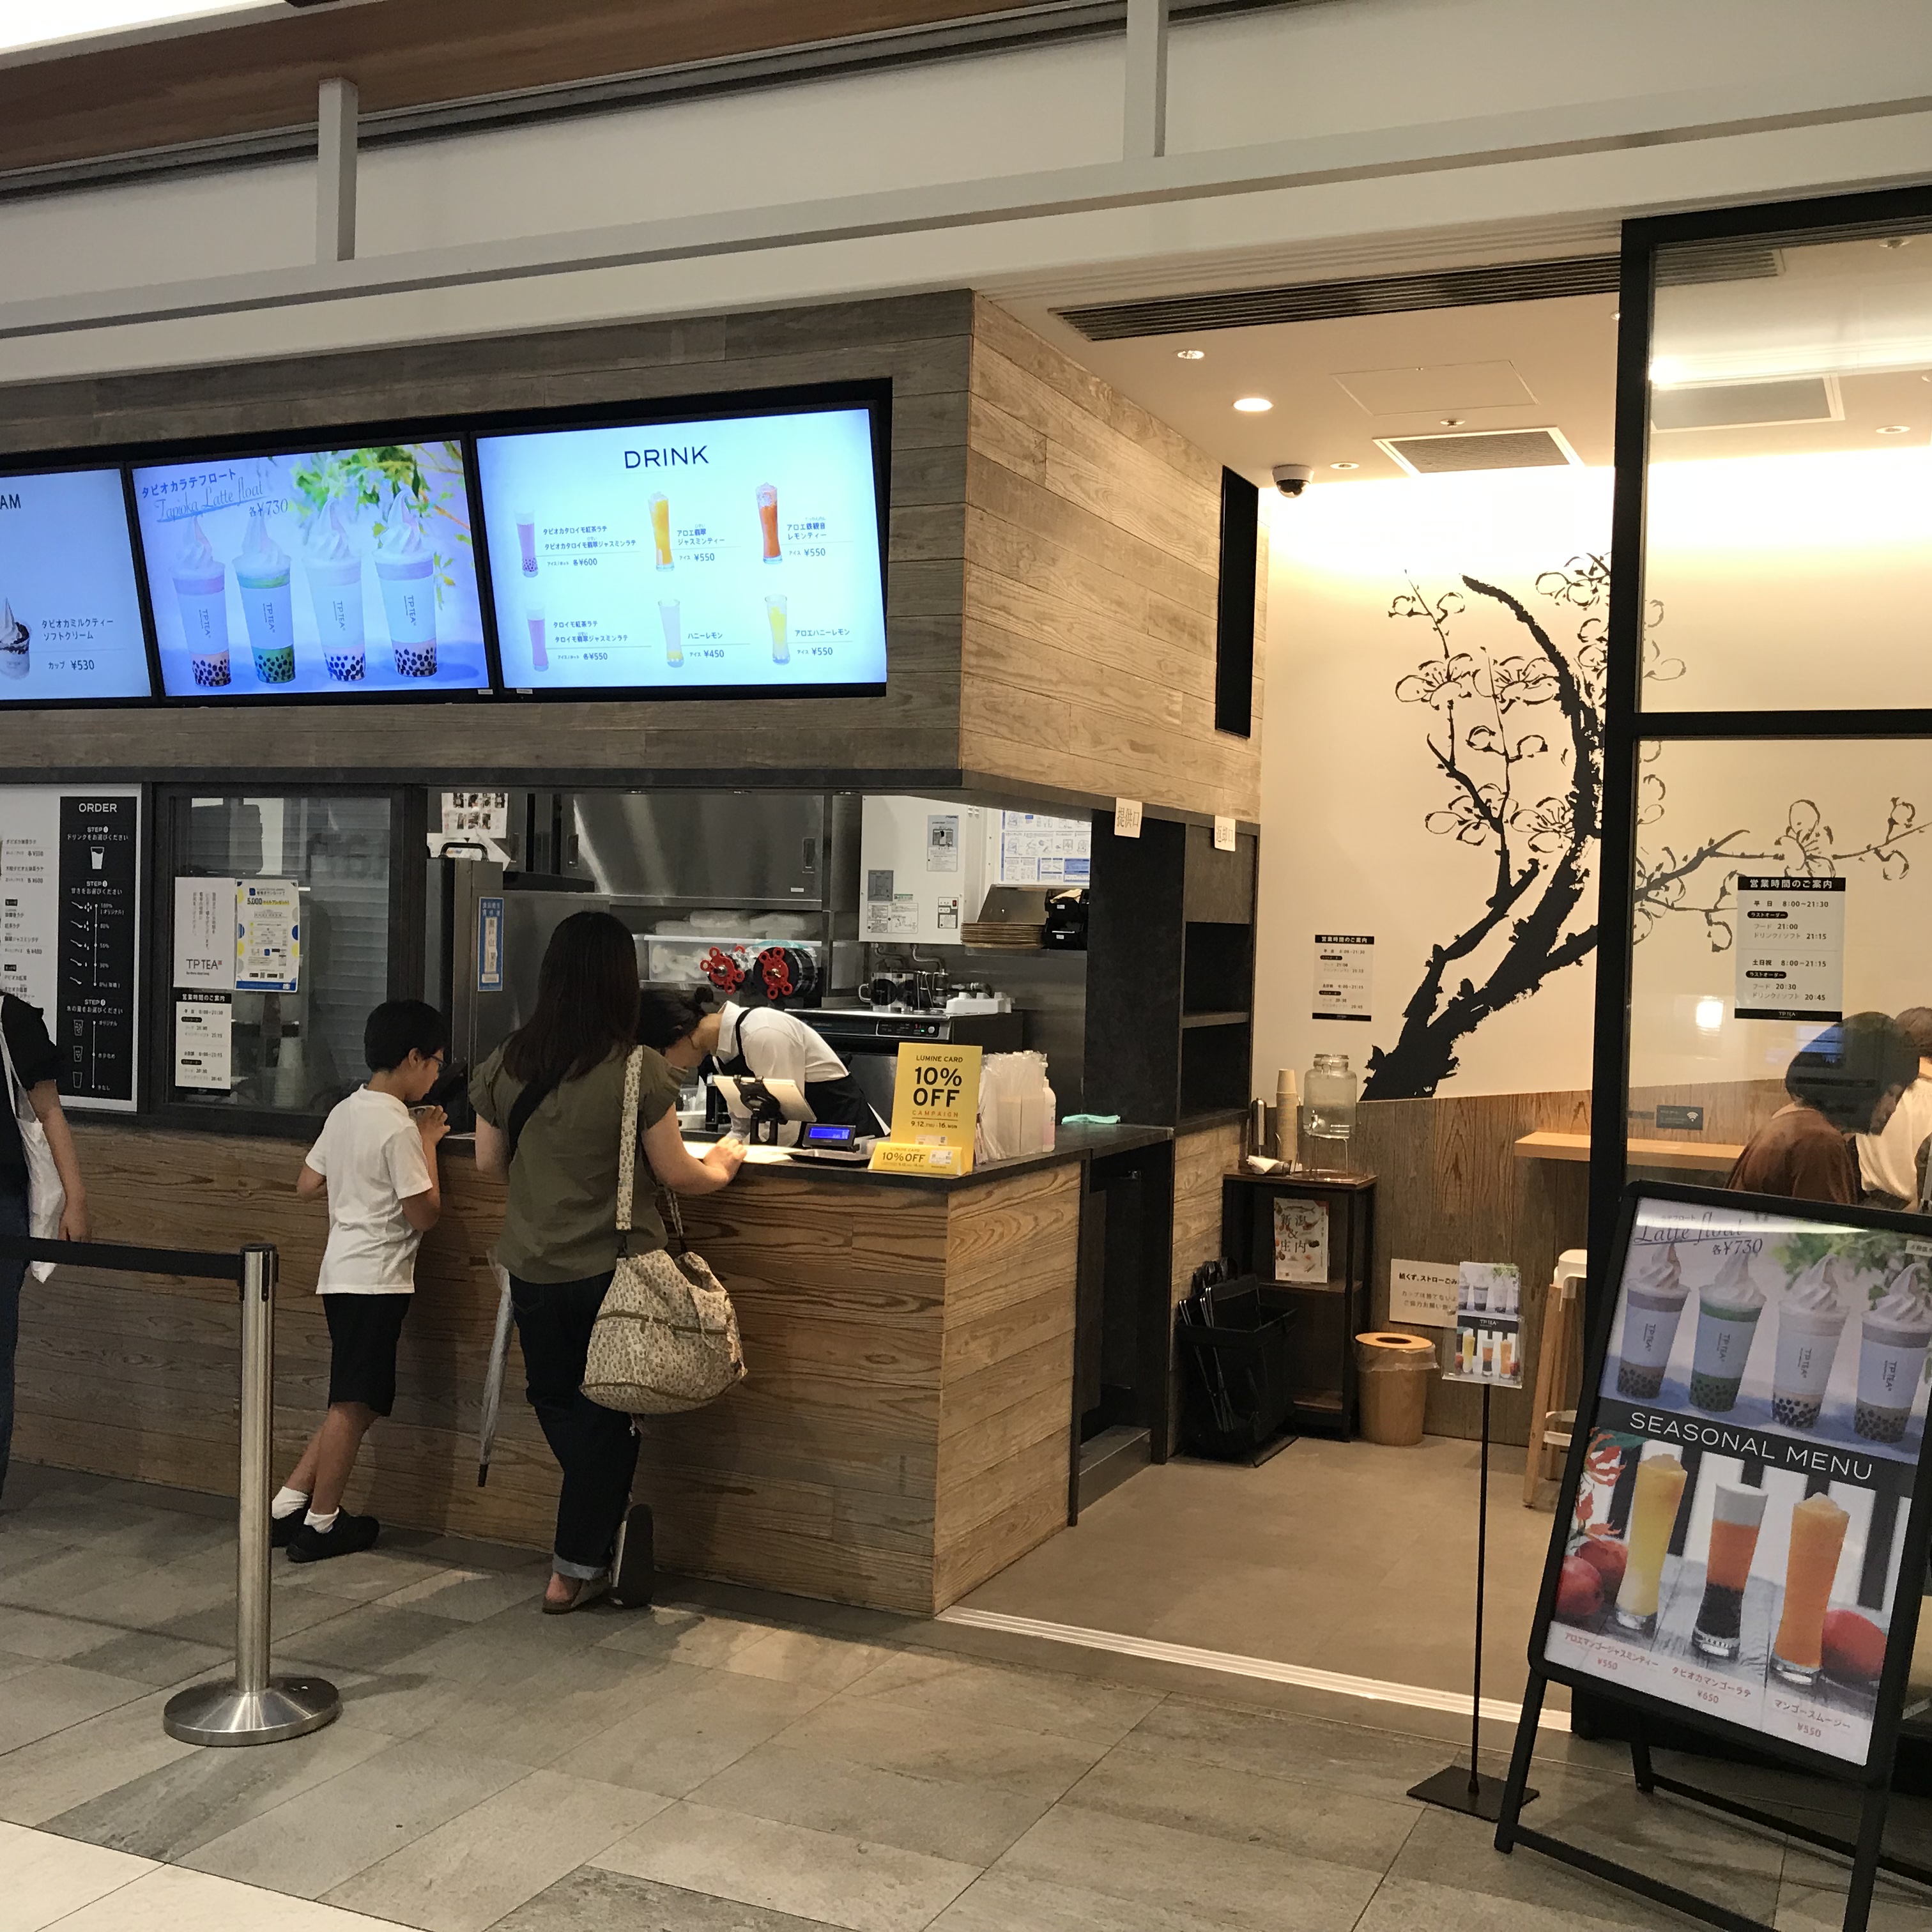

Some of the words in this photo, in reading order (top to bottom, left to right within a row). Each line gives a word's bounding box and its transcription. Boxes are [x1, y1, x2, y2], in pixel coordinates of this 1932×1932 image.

[624, 445, 710, 469] DRINK
[142, 468, 236, 498] タピオカラテフロート
[155, 492, 198, 521] Tapioka
[201, 486, 234, 509] Latte
[237, 476, 264, 506] float
[542, 526, 608, 535] タピオカタロイモ紅茶ラテ
[786, 522, 825, 531] アロエ鉄観音
[678, 537, 724, 546] ジャスミンティー
[788, 532, 827, 540] レモンティー
[694, 553, 715, 562] ¥550
[804, 548, 825, 557] ¥550
[42, 618, 113, 629] タピオカミルクティー
[553, 620, 598, 629] タロイモ紅茶ラテ
[43, 631, 94, 641] ソフトクリーム
[583, 652, 608, 661] 各¥550
[703, 649, 724, 658] ¥450
[811, 647, 833, 656] ¥550
[48, 661, 65, 670] カップ
[70, 659, 95, 670] ¥530
[79, 802, 118, 813] ORDER
[67, 833, 128, 841] ドリンクをお選びください
[1749, 879, 1832, 889] 営業時間のご案内
[915, 1066, 962, 1087] 10%
[913, 1087, 960, 1107] OFF
[912, 1110, 958, 1118] CAMPAIGN
[1633, 1217, 1689, 1243] Latte
[1694, 1211, 1742, 1245] float
[1287, 1229, 1298, 1239] &
[1280, 1239, 1306, 1253] 庄内
[1630, 1412, 1775, 1459] SEASONAL
[1786, 1445, 1873, 1480] MENU
[1565, 1632, 1659, 1666] アロエマンゴージャスミンティー
[1597, 1658, 1618, 1670] ¥550
[1671, 1666, 1751, 1697] タピオカマンゴーラテ
[1697, 1689, 1719, 1704] ¥650
[1797, 1722, 1821, 1737] ¥550
